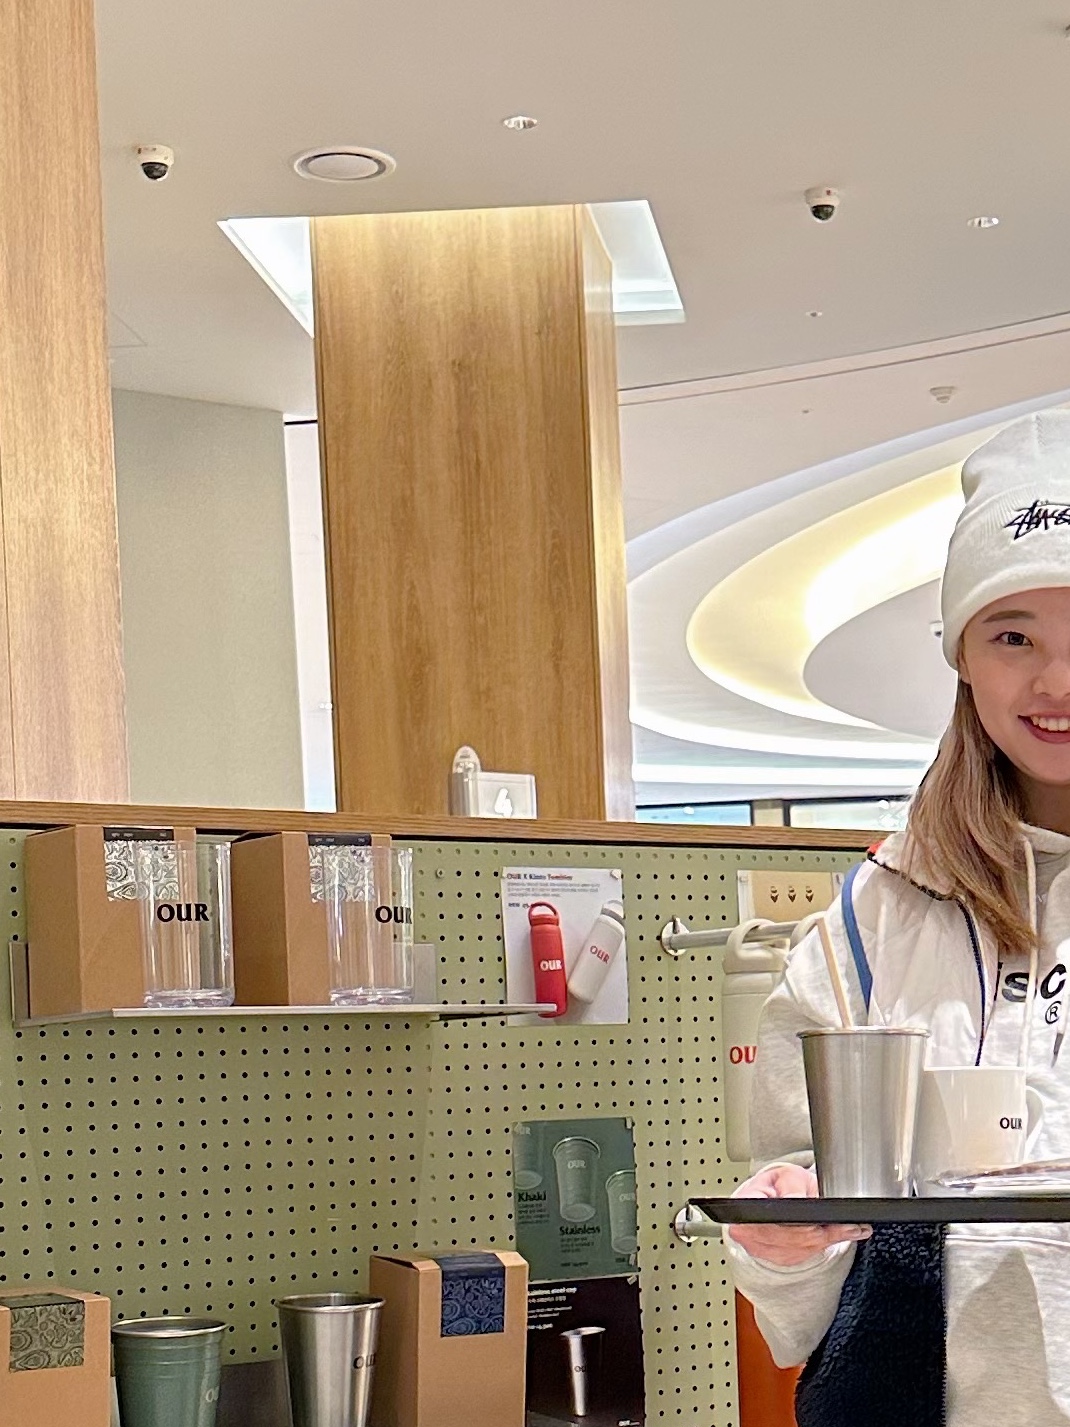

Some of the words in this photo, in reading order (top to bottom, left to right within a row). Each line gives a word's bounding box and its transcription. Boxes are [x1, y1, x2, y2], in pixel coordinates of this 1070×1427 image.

[494, 787, 513, 818] 4
[156, 902, 210, 923] OUR
[375, 904, 413, 924] OUR
[540, 958, 563, 971] OUR
[589, 945, 610, 965] OUR
[999, 1116, 1023, 1130] OUR
[567, 1159, 586, 1169] OUR
